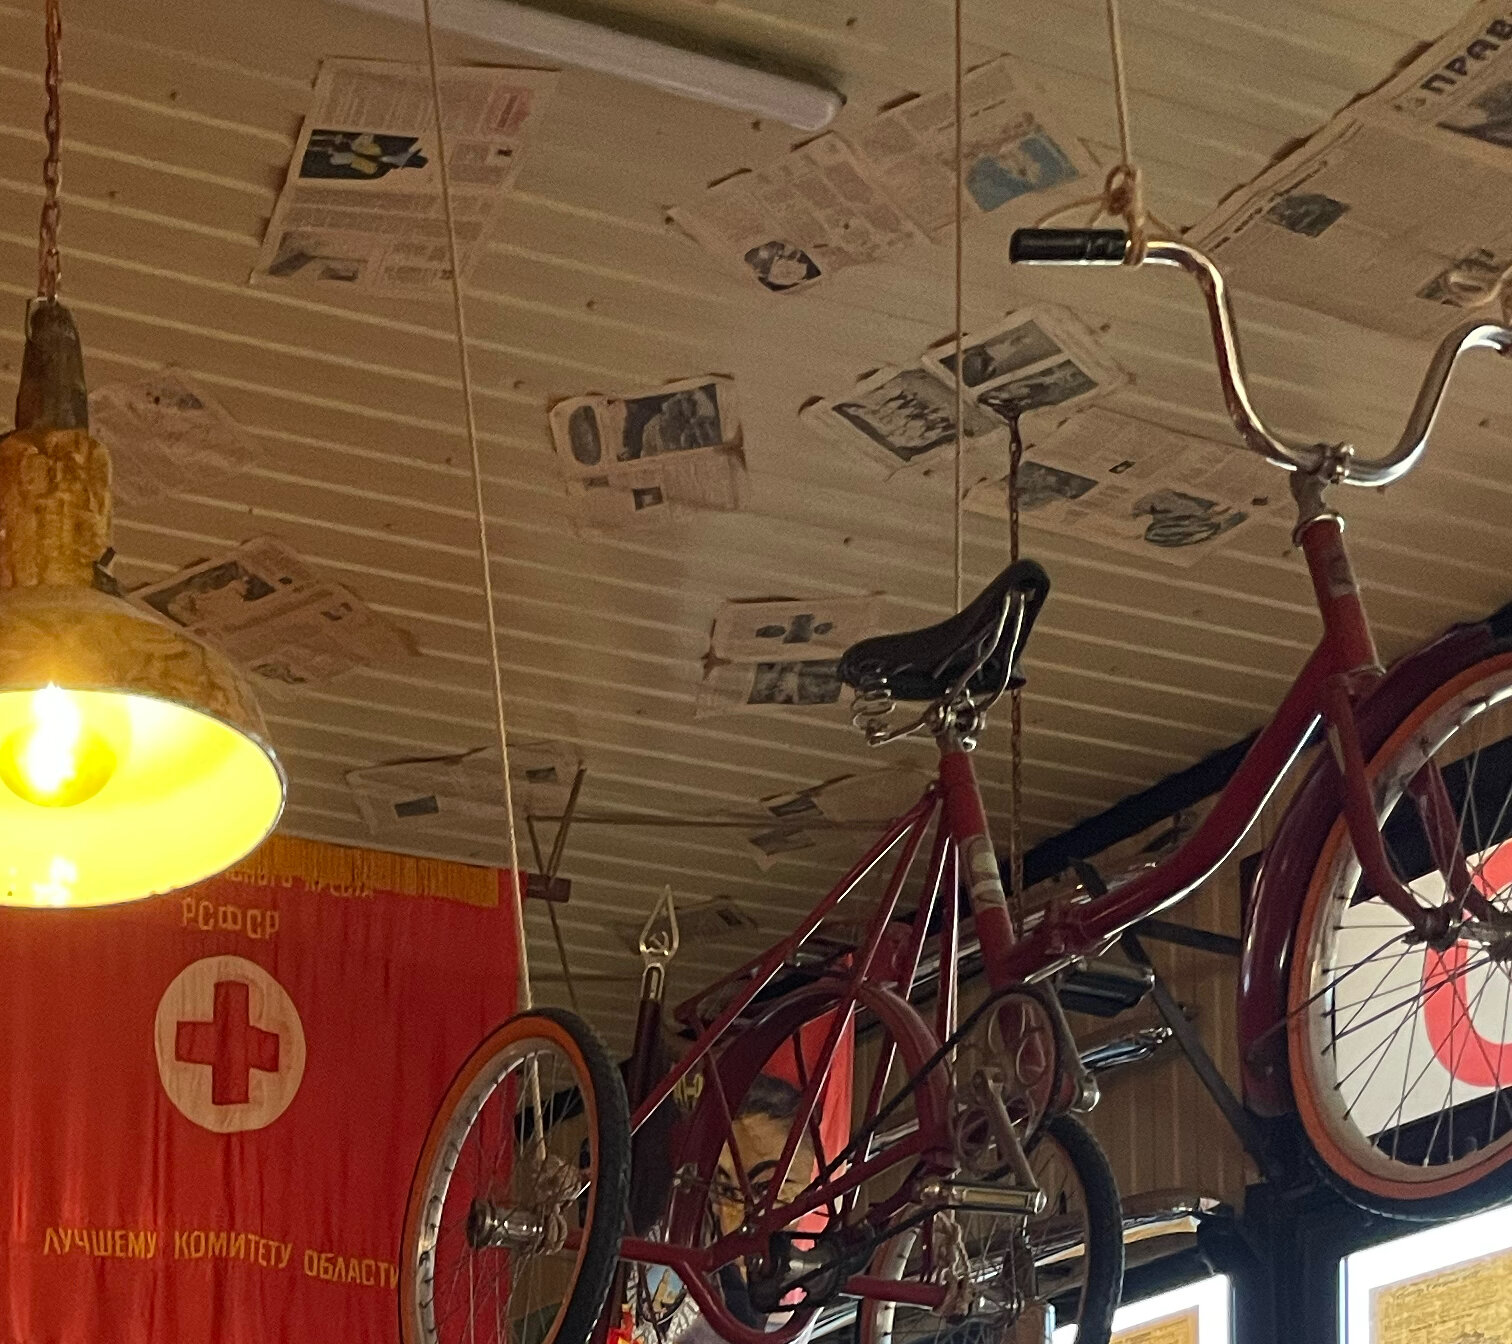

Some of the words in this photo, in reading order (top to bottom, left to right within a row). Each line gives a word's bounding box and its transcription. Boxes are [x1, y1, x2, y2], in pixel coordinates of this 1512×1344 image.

[181, 897, 280, 940] РСФСР
[43, 1227, 157, 1259] ЛУЧШЕМУ
[174, 1231, 292, 1270] КОМИТЕТУ
